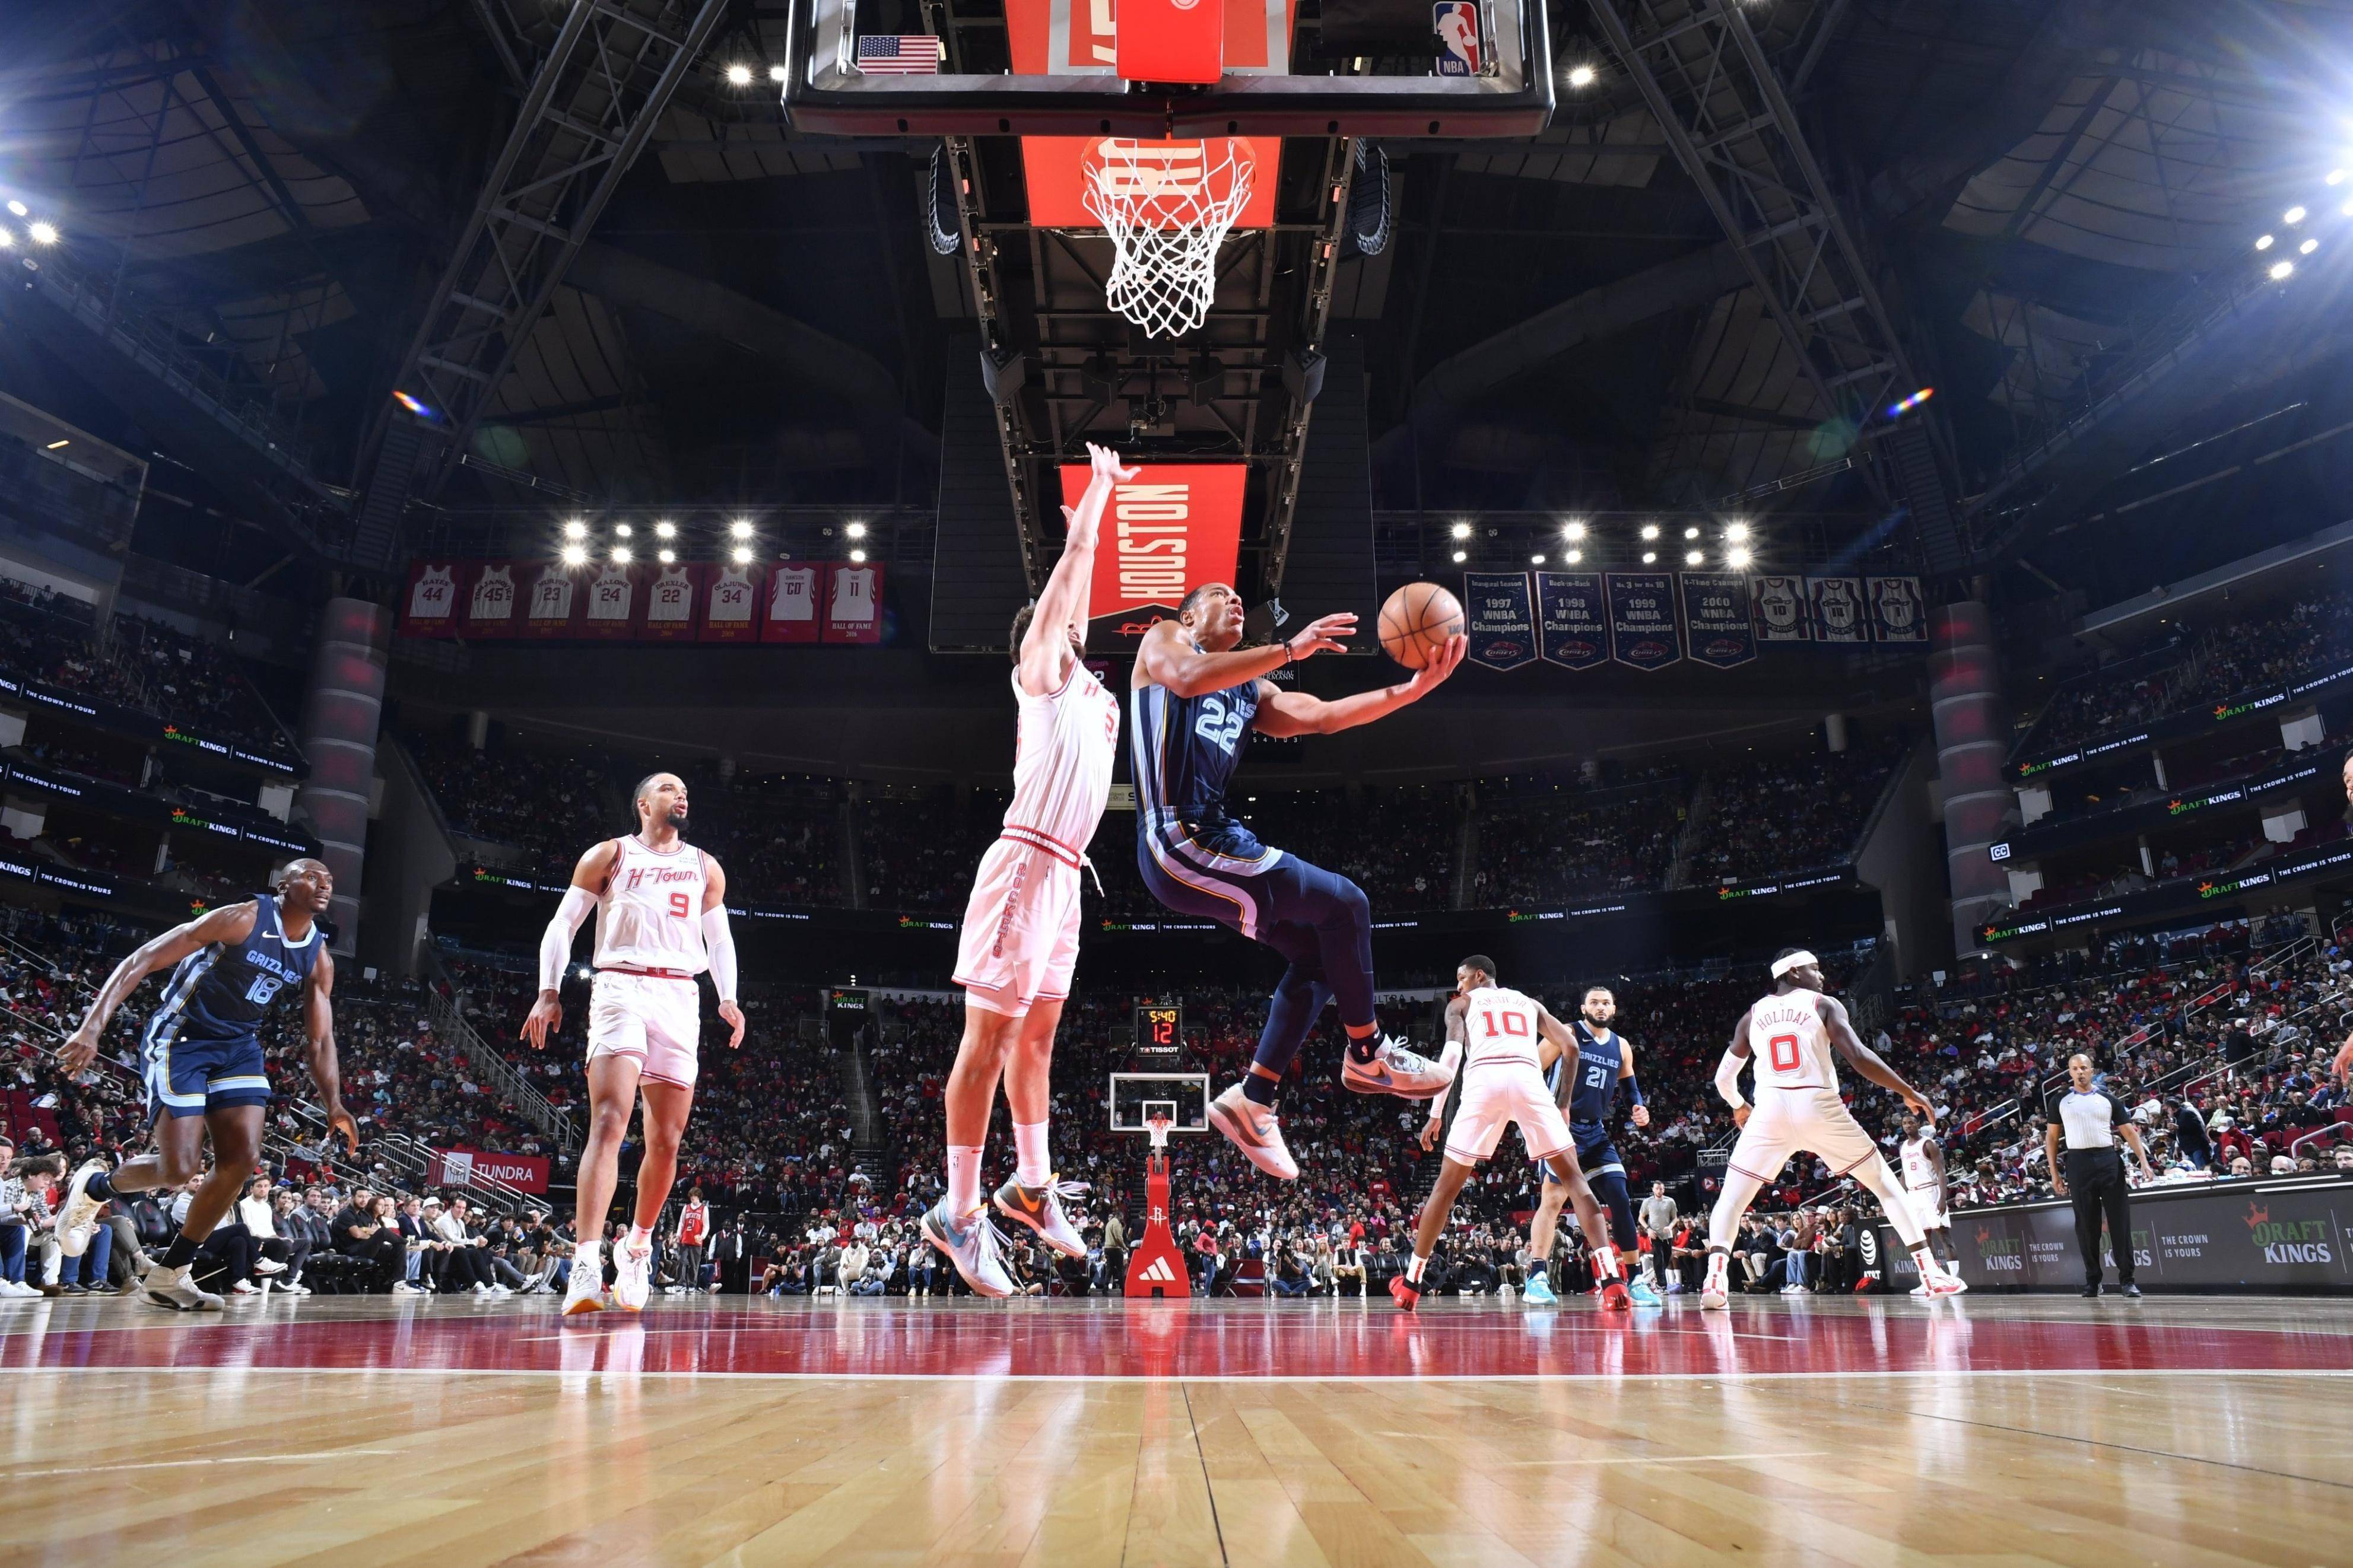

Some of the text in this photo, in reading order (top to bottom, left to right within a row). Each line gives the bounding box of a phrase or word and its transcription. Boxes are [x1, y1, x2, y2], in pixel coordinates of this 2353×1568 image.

[1443, 61, 1464, 73] NBA
[1115, 484, 1189, 599] HOUSTON
[538, 578, 570, 588] MURPHY
[595, 579, 630, 589] MALONE
[656, 581, 689, 590] DREXLER
[715, 581, 751, 591] OLAJUWON
[850, 582, 859, 596] 11
[423, 587, 443, 601] 44
[484, 588, 503, 601] 45
[544, 587, 561, 601] 23
[601, 588, 621, 602] 24
[662, 590, 680, 603] 22
[722, 590, 741, 603] 34
[1486, 599, 1511, 609] 1997
[1558, 598, 1586, 608] 1998
[1629, 599, 1656, 609] 1999
[1702, 597, 1731, 607] 2000
[1483, 610, 1517, 621] WNBA
[1555, 610, 1590, 620] WNBA
[1626, 610, 1662, 621] WNBA
[1700, 609, 1736, 619] WNBA
[1472, 621, 1530, 634] Champions
[1544, 621, 1603, 634] Champions
[1616, 622, 1674, 634] Champions
[1690, 620, 1749, 632] Champions
[26, 689, 37, 698] THE
[39, 694, 65, 706] CROWN
[75, 704, 96, 715] YOURS
[2216, 693, 2285, 720] DRAFTKINGS
[2292, 686, 2304, 694] THE
[2306, 676, 2329, 689] CROWN
[1195, 697, 1244, 758] 22
[164, 732, 227, 754] DRAFTKINGS
[247, 754, 268, 765] CROWN
[275, 762, 294, 772] YOURS
[2022, 753, 2079, 777] DRAFTKINGS
[2098, 742, 2120, 752] CROWN
[2128, 734, 2148, 743] YOURS
[12, 771, 24, 780] THE
[25, 775, 49, 787] CROWN
[59, 785, 81, 796] YOURS
[2170, 790, 2241, 815] DRAFTKINGS
[2263, 777, 2286, 789] CROWN
[2295, 768, 2316, 779] YOURS
[172, 815, 237, 835] DRAFTKINGS
[258, 835, 280, 845] CROWN
[288, 842, 306, 851] YOURS
[1994, 847, 2007, 857] CC
[475, 874, 532, 889] DRAFTKINGS
[625, 867, 698, 891] H-Town
[2201, 874, 2270, 898] DRAFTKINGS
[2292, 861, 2318, 873] CROWN
[2327, 853, 2351, 864] YOURS
[41, 873, 53, 881] THE
[54, 877, 78, 888] CROWN
[88, 885, 112, 895] YOURS
[1720, 886, 1777, 900] DRAFTKINGS
[668, 891, 690, 920] 9
[993, 863, 1027, 959] ROCKETS
[1509, 912, 1564, 922] DRAFTKINGS
[900, 921, 954, 930] DRAFTKINGS
[1986, 922, 2047, 942] DRAFTKINGS
[2068, 914, 2091, 923] CROWN
[2100, 907, 2122, 917] YOURS
[244, 972, 283, 1004] 18
[1150, 1010, 1176, 1023] 5:40
[1757, 1009, 1811, 1031] HOLIDAY
[1481, 1010, 1529, 1039] 10
[1154, 1023, 1172, 1044] 12
[1579, 1051, 1620, 1068] GRIZZLIES
[1767, 1032, 1803, 1075] 0
[1586, 1066, 1608, 1090] 21
[477, 1163, 534, 1181] TUNDRA
[2161, 1235, 2209, 1246] THE CROWN
[2252, 1221, 2326, 1247] DRAFT
[1980, 1239, 2019, 1258] DRAFT
[2041, 1242, 2064, 1251] CROWN
[2165, 1248, 2201, 1258] IS YOURS
[2264, 1243, 2332, 1263] KINGS
[1986, 1255, 2022, 1270] KINGS
[2032, 1254, 2059, 1263] IS YOURS
